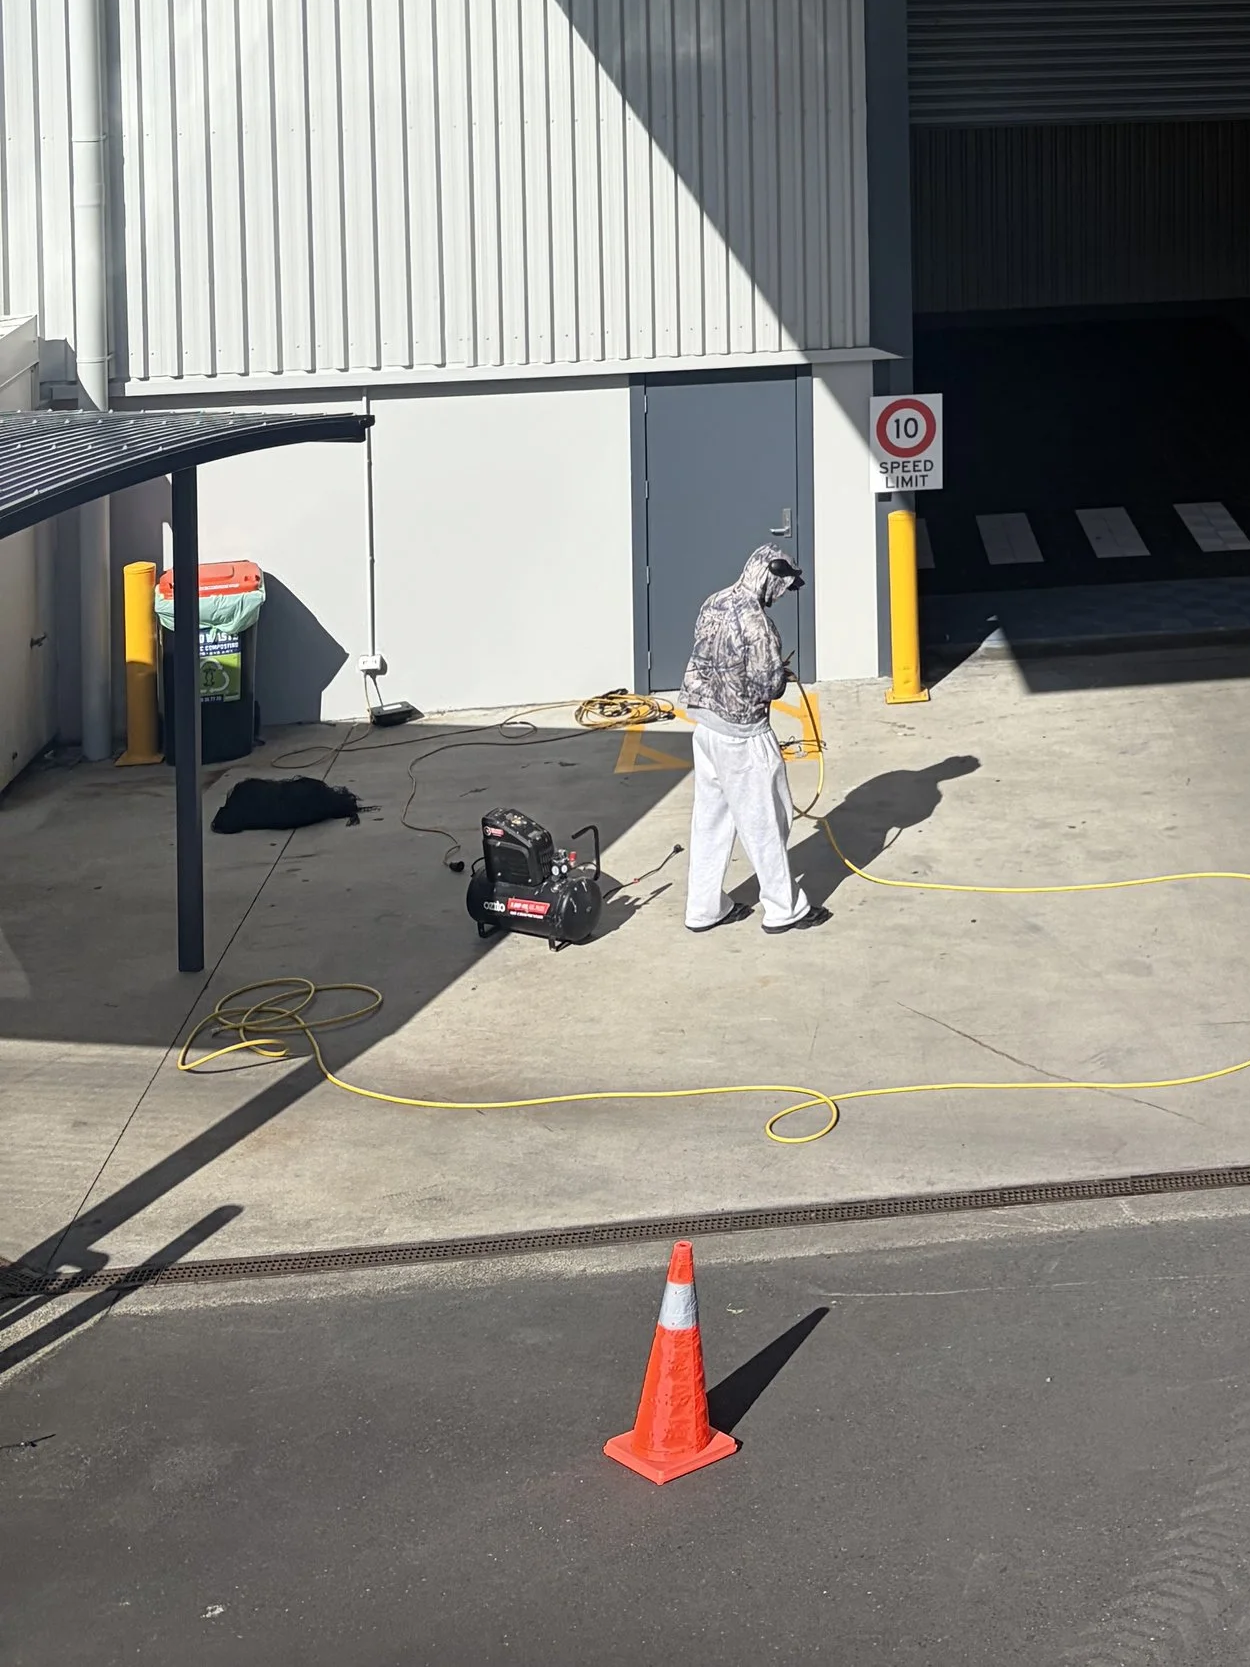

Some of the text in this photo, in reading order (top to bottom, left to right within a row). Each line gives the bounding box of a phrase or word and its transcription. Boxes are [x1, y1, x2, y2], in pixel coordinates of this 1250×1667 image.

[894, 417, 919, 439] 10
[879, 459, 934, 474] SPEED
[885, 474, 928, 489] LIMIT
